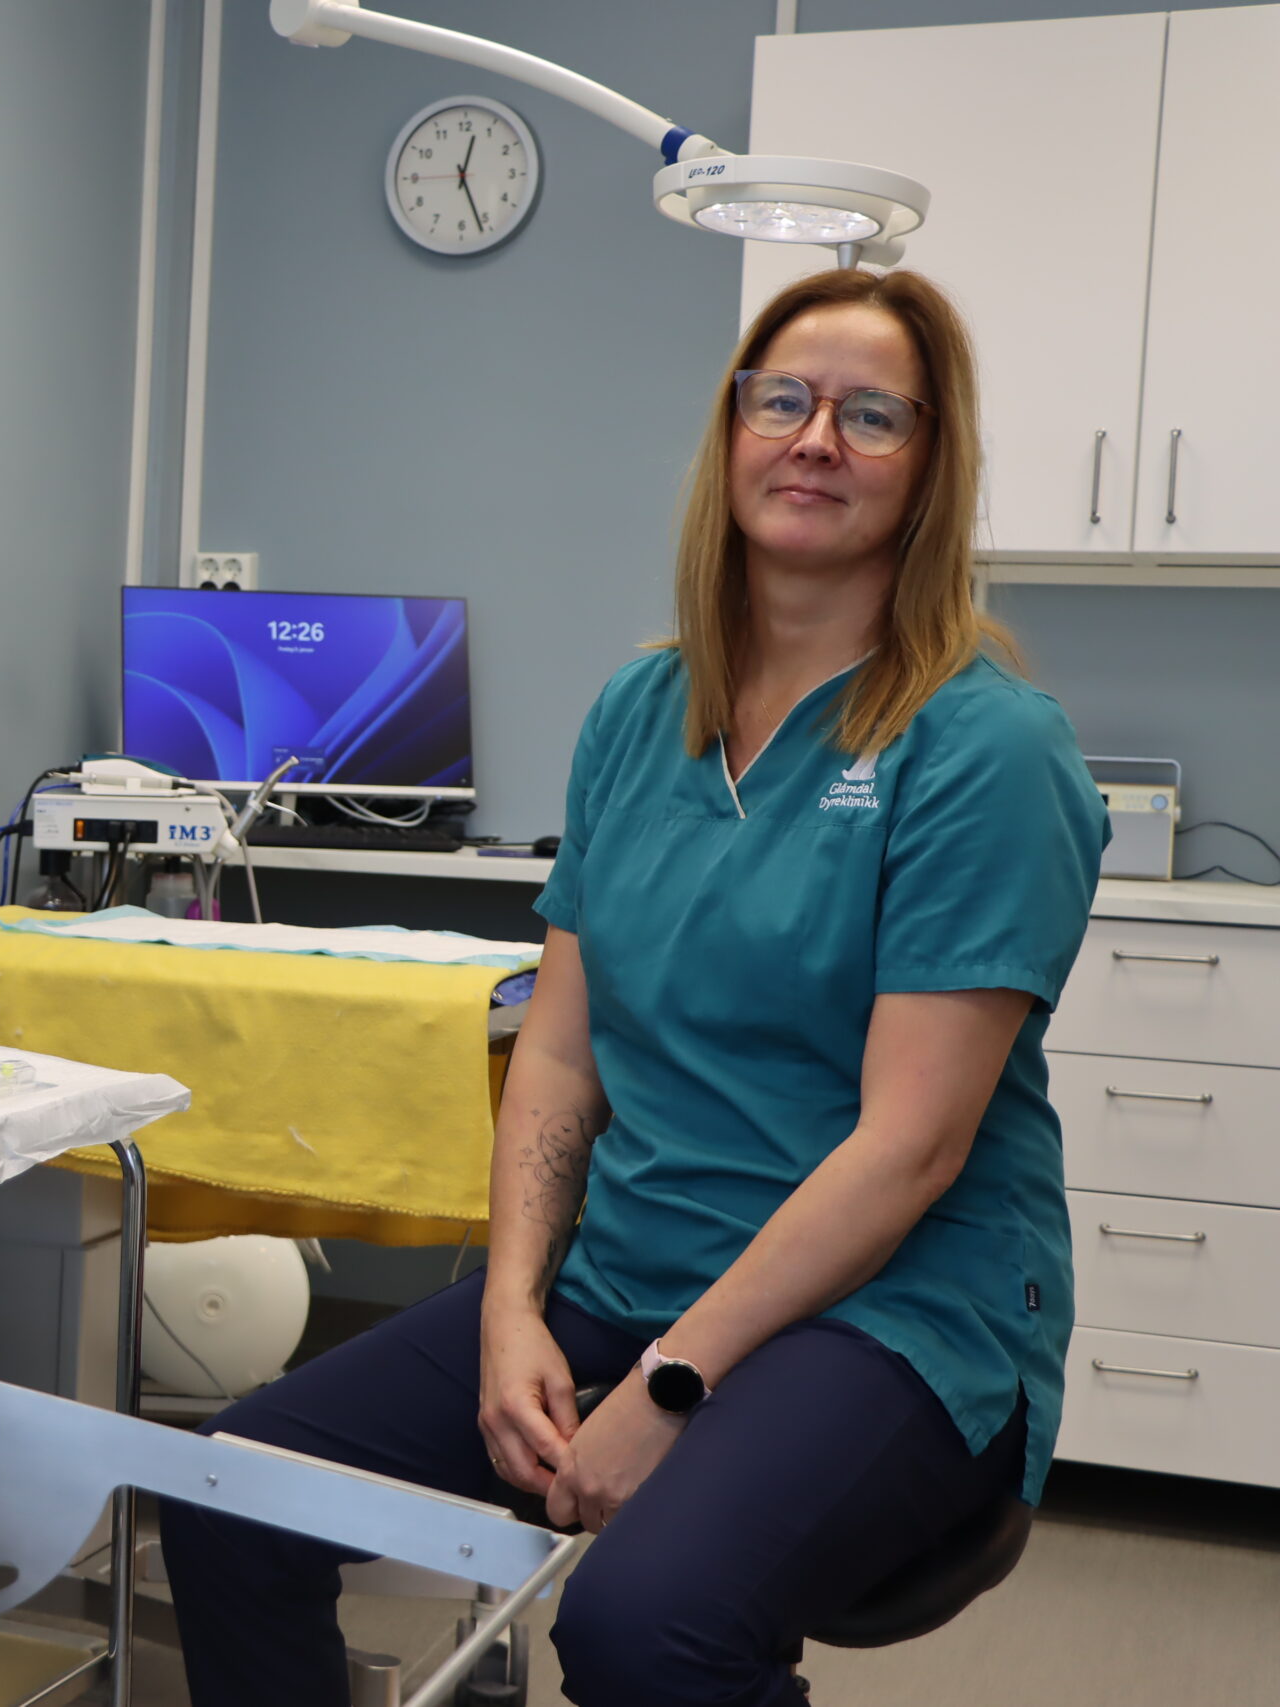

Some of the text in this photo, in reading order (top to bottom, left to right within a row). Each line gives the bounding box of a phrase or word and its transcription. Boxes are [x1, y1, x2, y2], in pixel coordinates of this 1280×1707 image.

[458, 121, 472, 132] 12
[436, 130, 447, 140] 11
[419, 148, 433, 159] 10
[501, 144, 510, 156] 2
[411, 172, 419, 184] 9
[508, 168, 516, 180] 3
[416, 196, 424, 207] 8
[501, 192, 508, 202] 4
[433, 213, 440, 224] 7
[481, 212, 489, 223] 5
[457, 220, 466, 231] 6
[267, 620, 325, 642] 12:26
[829, 782, 875, 795] Glåmdal
[819, 795, 880, 811] Dyreklinikk
